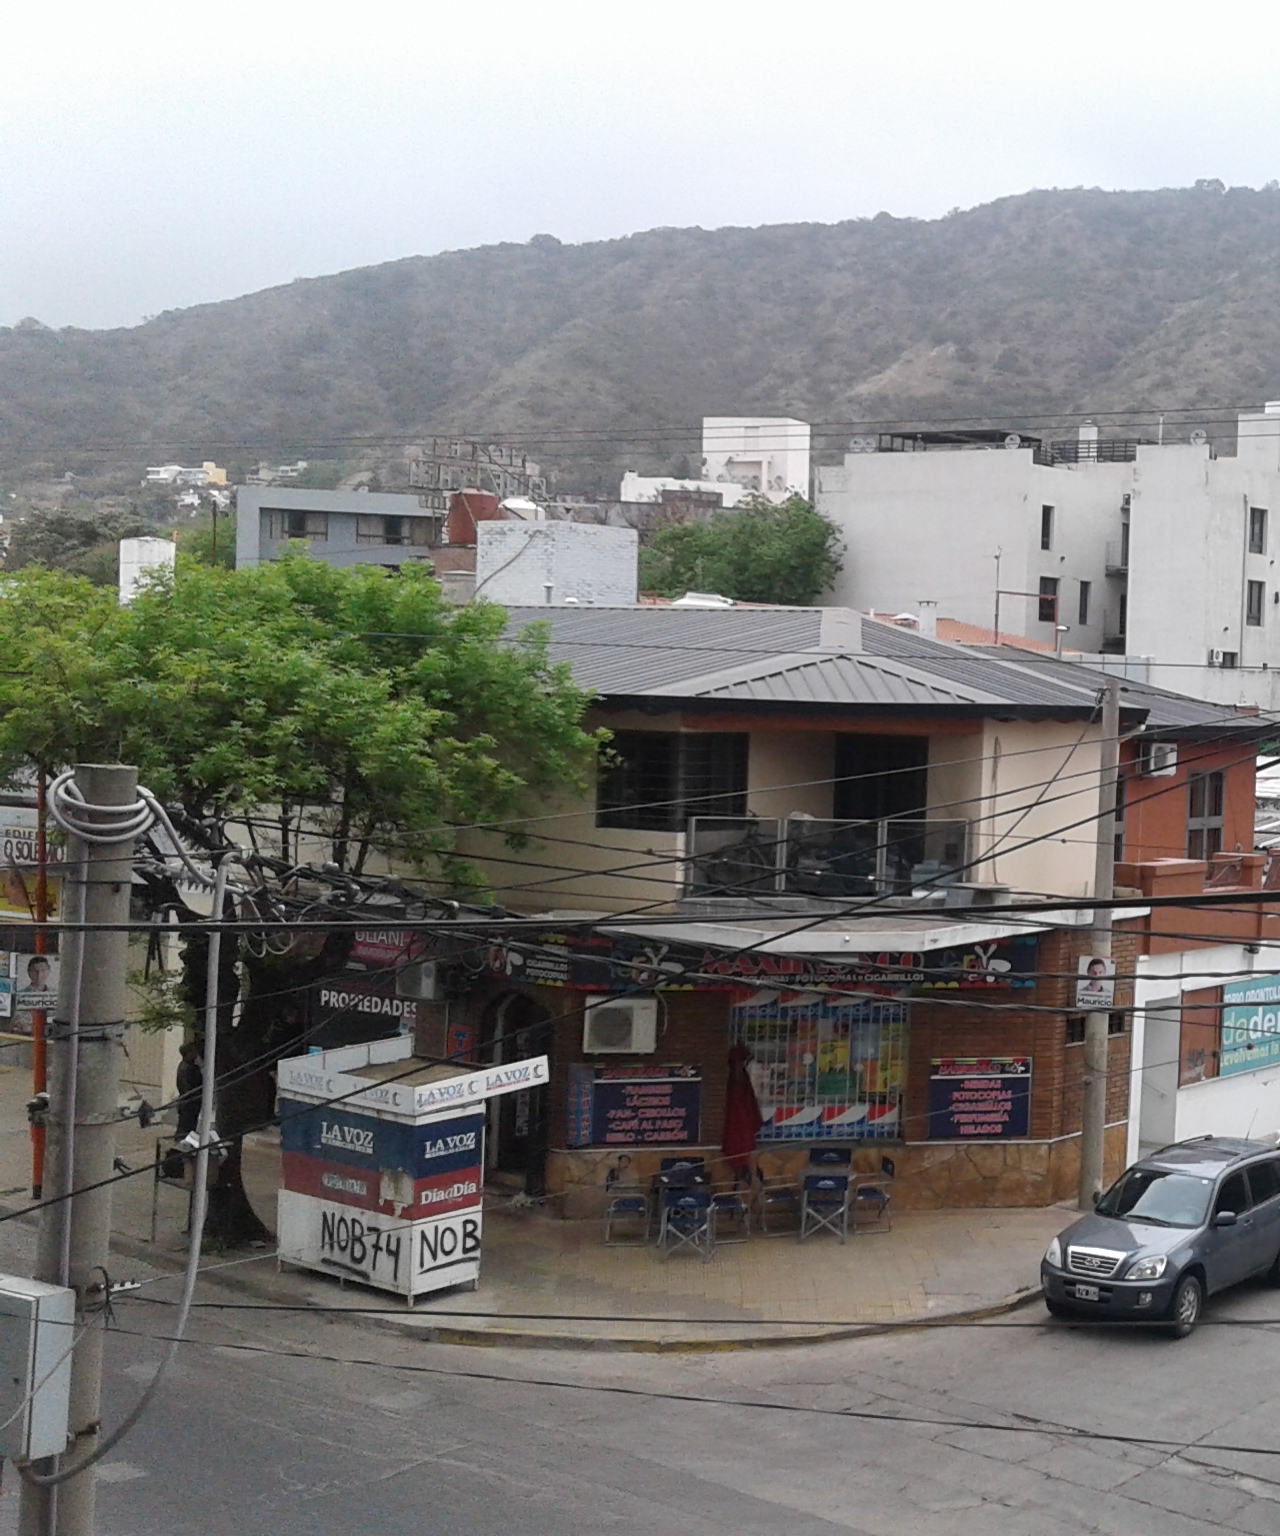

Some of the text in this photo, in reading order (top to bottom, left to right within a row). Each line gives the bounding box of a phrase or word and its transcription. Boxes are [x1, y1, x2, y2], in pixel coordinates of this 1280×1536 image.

[864, 973, 925, 982] CIGARRILLOS
[321, 990, 417, 1018] PROPIEDADES
[1077, 997, 1113, 1007] Mauricio
[486, 1074, 503, 1087] LA
[504, 1067, 531, 1081] VOZ
[438, 1083, 465, 1098] VOZ
[321, 1121, 342, 1140] LA
[343, 1126, 374, 1147] VOZ
[425, 1139, 445, 1153] LA
[446, 1132, 476, 1147] VOZ
[420, 1218, 481, 1270] NOB
